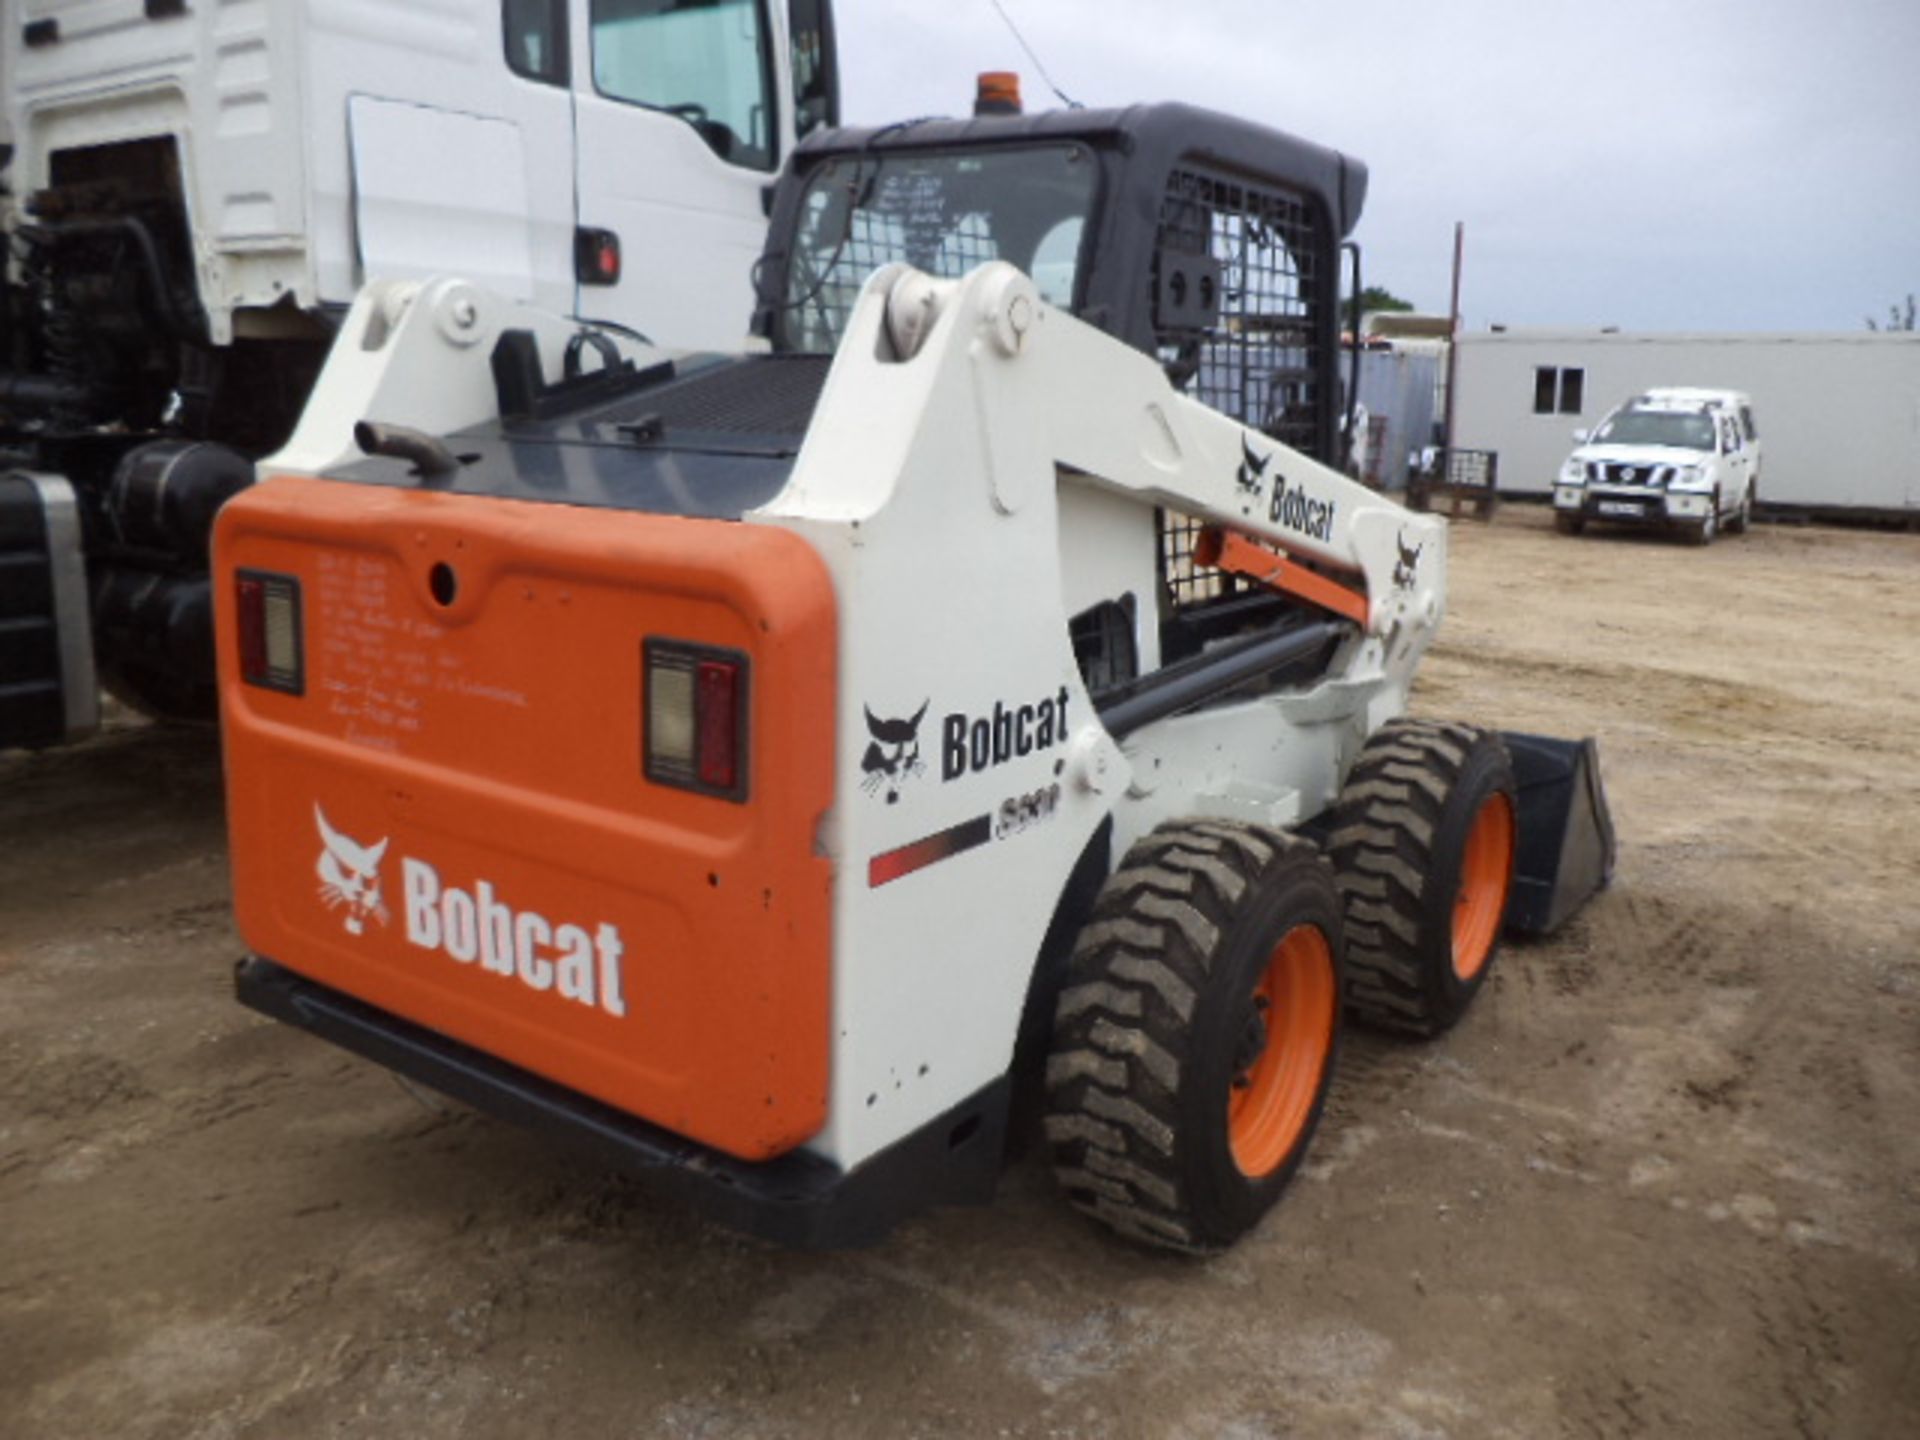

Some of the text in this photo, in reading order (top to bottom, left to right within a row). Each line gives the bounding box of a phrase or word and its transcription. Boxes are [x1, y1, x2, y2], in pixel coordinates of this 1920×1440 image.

[1269, 474, 1336, 543] Bobcat
[942, 686, 1069, 782] Bobcat
[403, 858, 625, 1016] Bobcat
